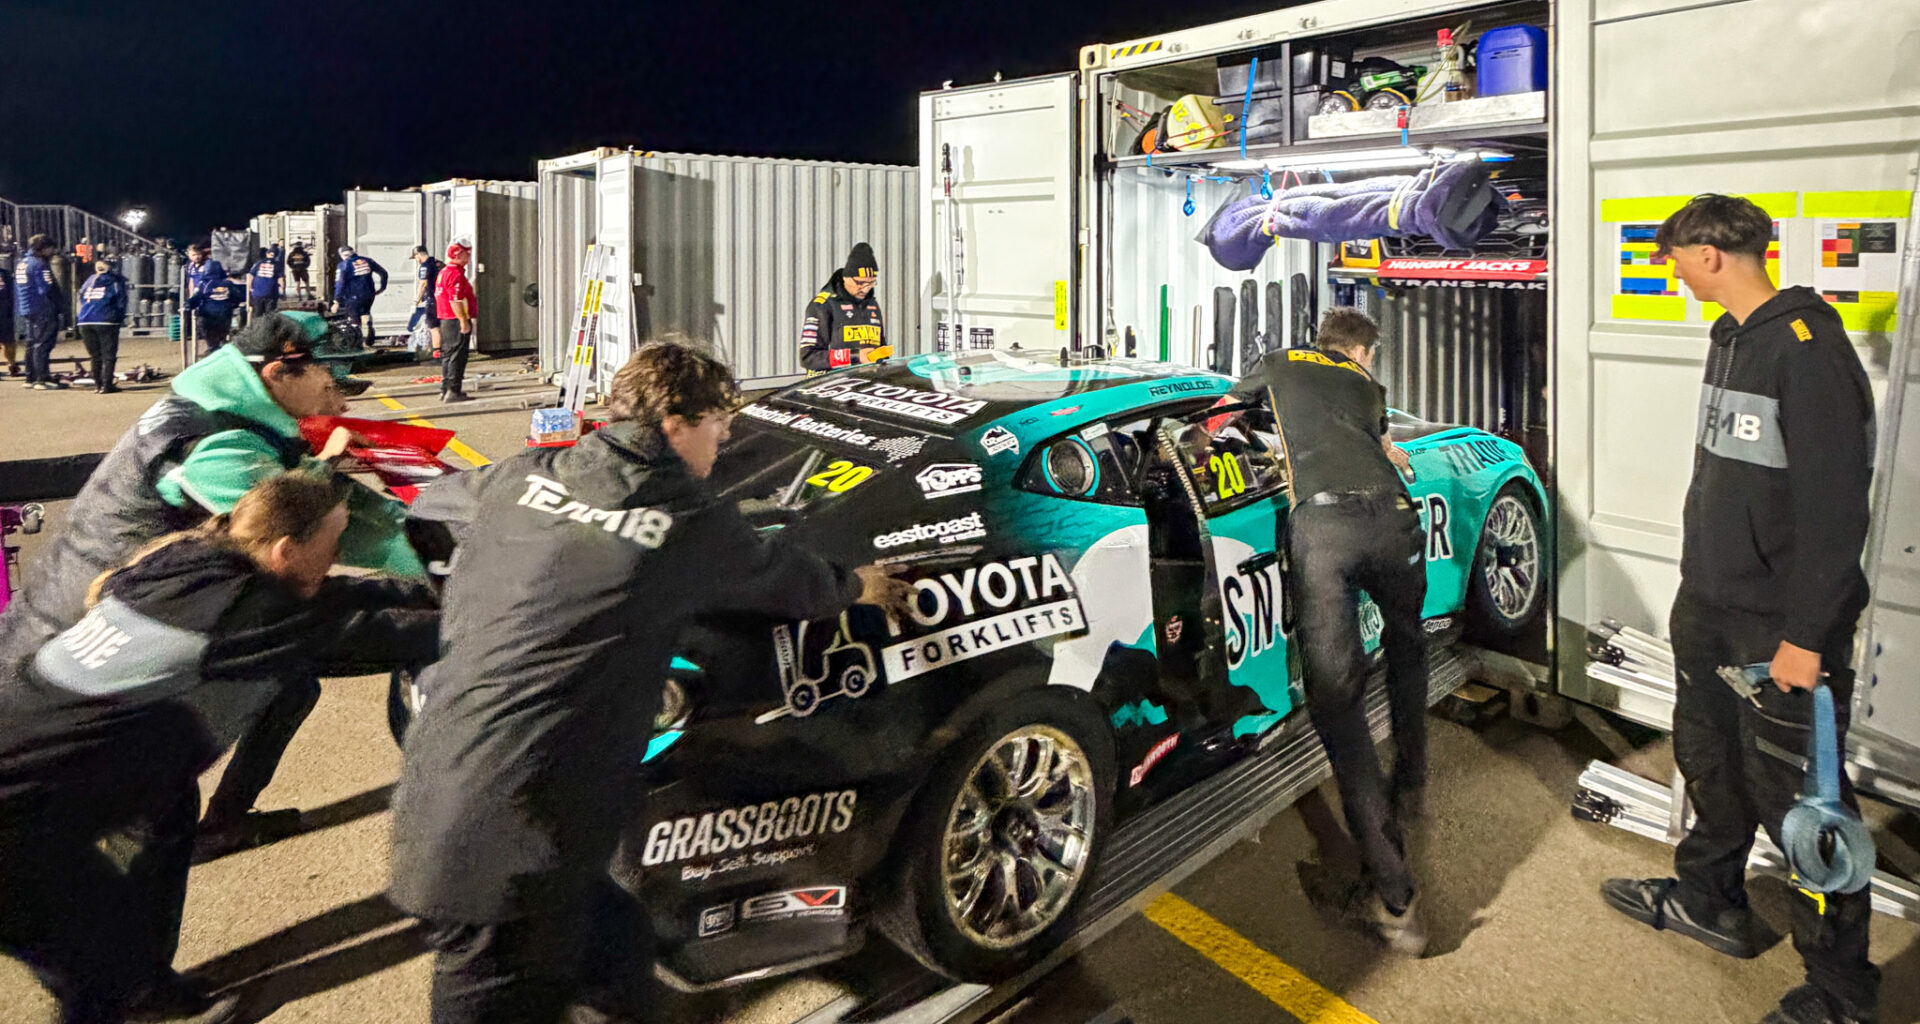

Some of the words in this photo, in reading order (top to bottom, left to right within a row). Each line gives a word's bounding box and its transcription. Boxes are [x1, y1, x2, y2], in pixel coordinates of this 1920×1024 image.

[1388, 260, 1462, 270] HUNGRY
[860, 382, 988, 415] TOYOTA
[1148, 379, 1215, 397] REYNOLDS
[791, 415, 878, 446] Batteries
[805, 460, 874, 493] 20
[916, 466, 983, 491] TOPPS
[1209, 452, 1246, 500] 20
[517, 474, 673, 549] TEAM18
[873, 511, 985, 549] eastcoast
[889, 553, 1074, 628] OYOTA
[902, 607, 1075, 671] FORKLIFTS
